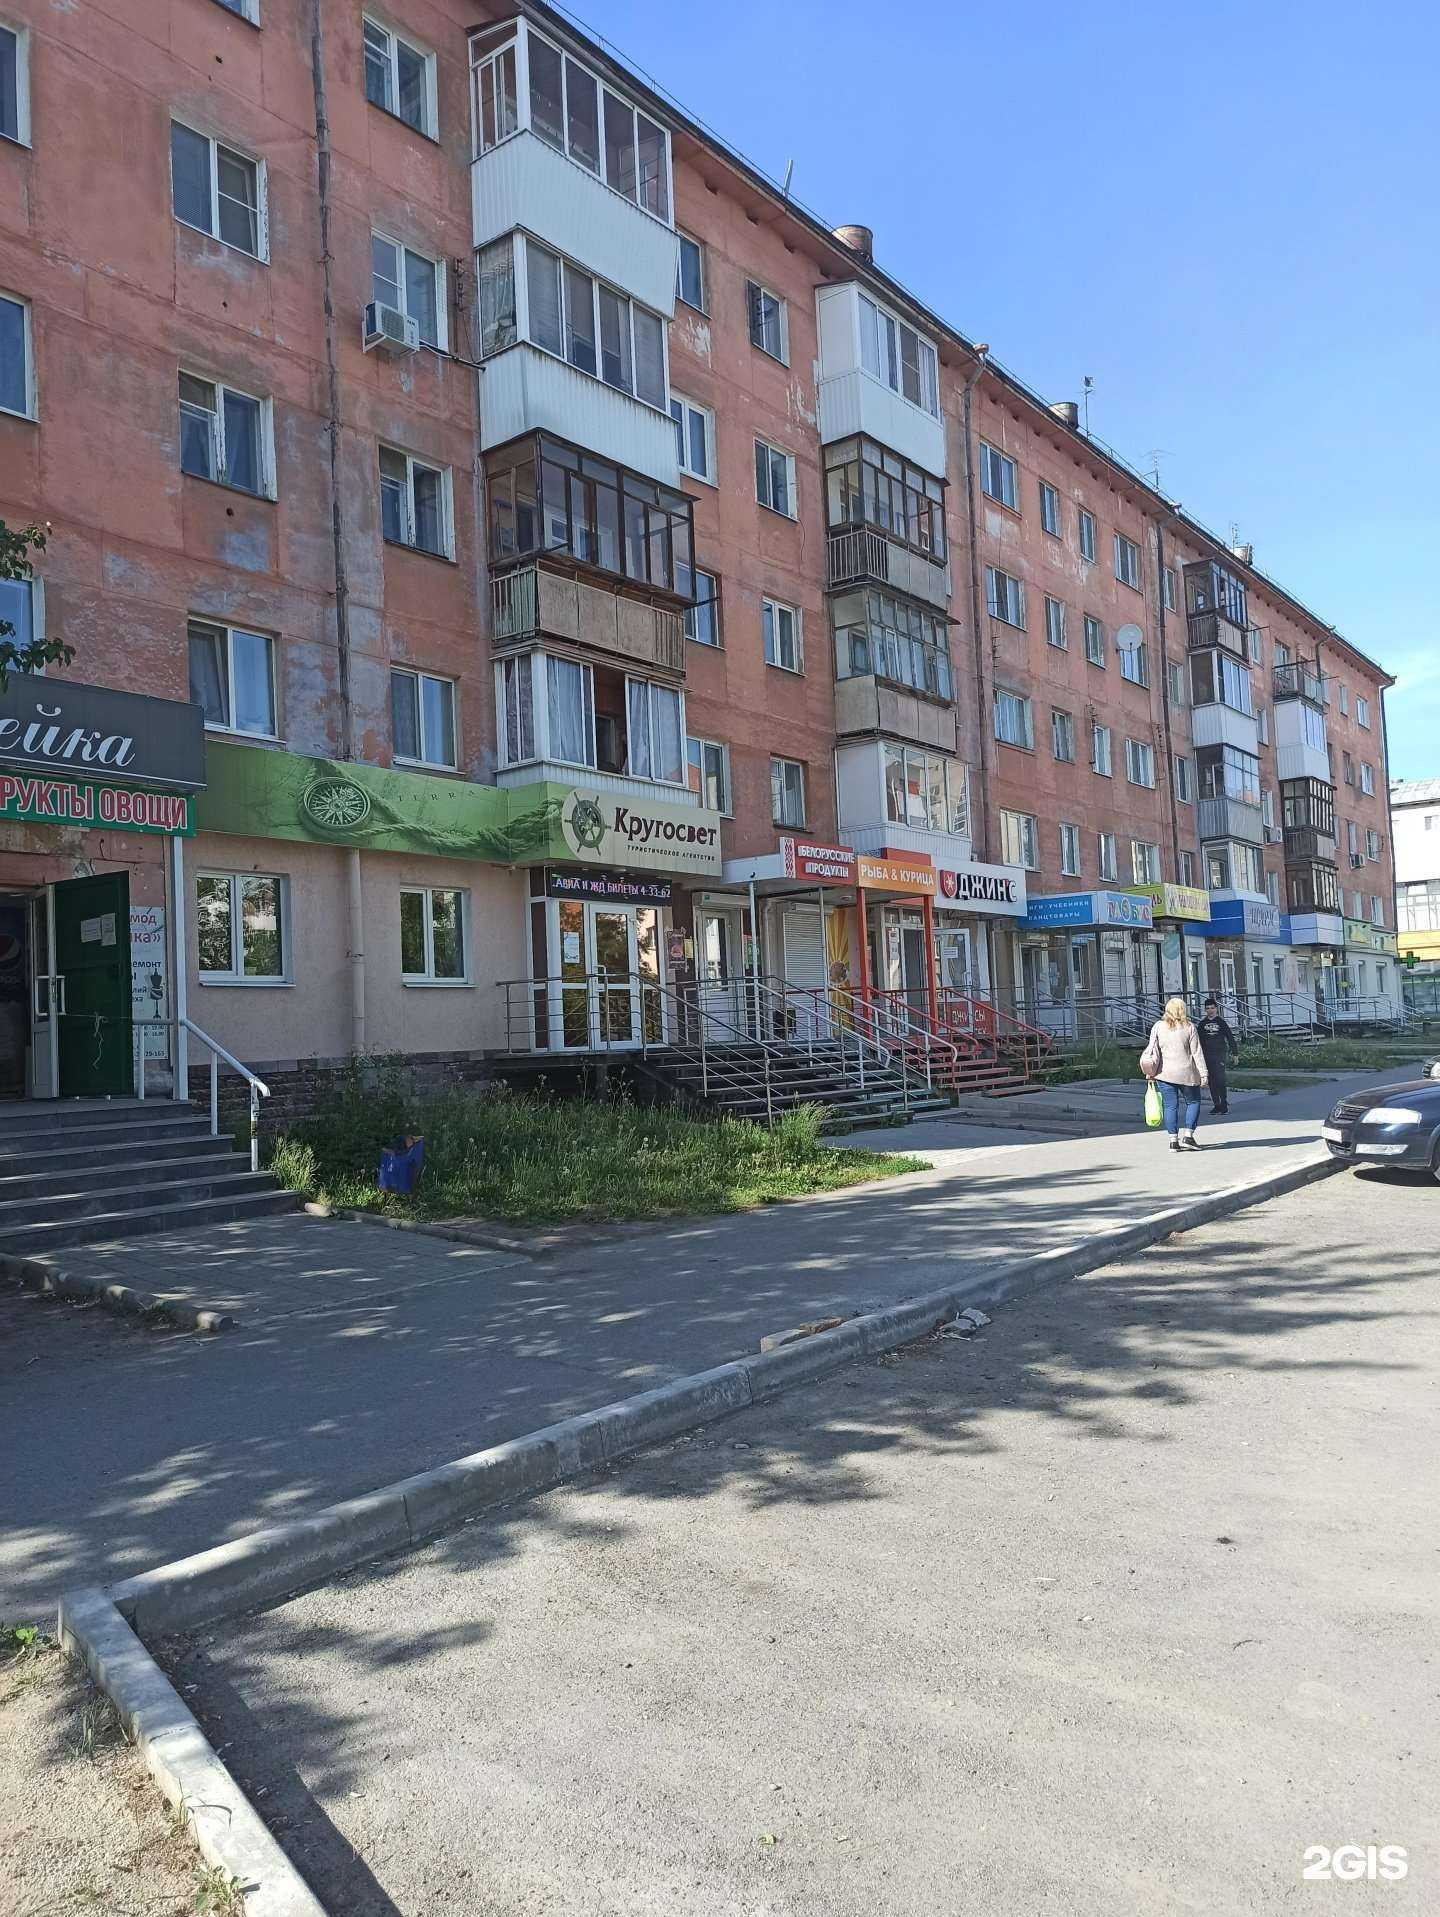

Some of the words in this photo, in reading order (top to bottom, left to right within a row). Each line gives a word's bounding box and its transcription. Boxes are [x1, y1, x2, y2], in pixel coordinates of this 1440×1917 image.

[0, 703, 136, 767] ейка
[99, 788, 188, 830] ОВОЩИ
[613, 806, 717, 846] Кругосвет
[798, 845, 855, 864] БЕЛОРУССКИЕ
[805, 861, 849, 878] ПРОДУКТЫ
[860, 863, 889, 880] РЫБА
[890, 868, 898, 881] &
[900, 869, 934, 887] КУРИЦА
[582, 880, 588, 890] И
[590, 881, 606, 893] ЖД
[607, 882, 639, 895] БИЛЕТЫ
[640, 885, 671, 898] 4-33-62
[130, 932, 161, 944] ка»
